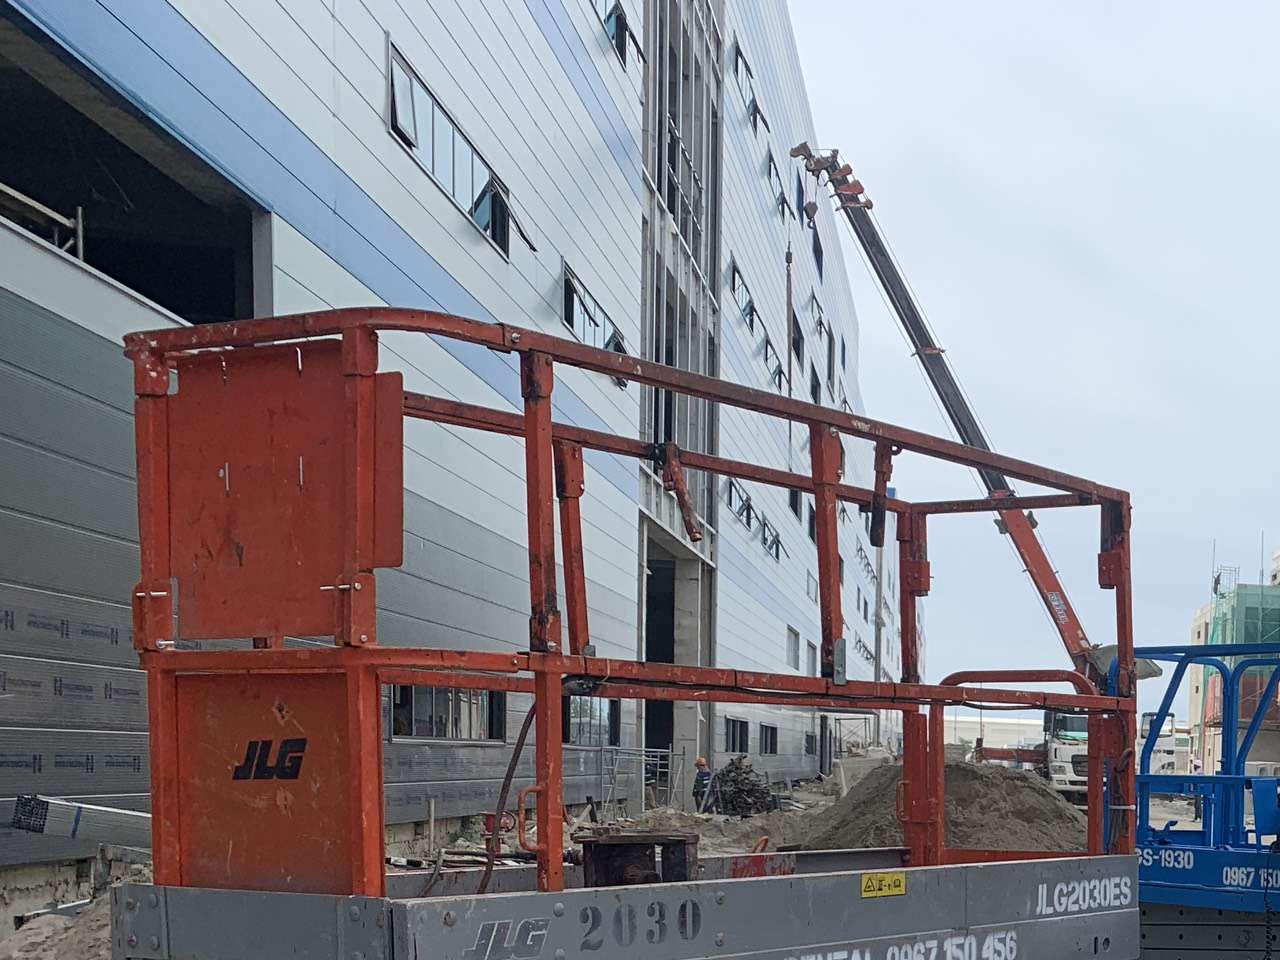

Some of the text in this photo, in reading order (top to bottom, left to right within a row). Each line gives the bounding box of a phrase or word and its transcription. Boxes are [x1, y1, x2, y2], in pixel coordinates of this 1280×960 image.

[232, 738, 307, 780] JLG
[1036, 876, 1132, 915] JLG2030ES
[1223, 866, 1254, 887] 0967
[1259, 869, 1280, 889] 150
[579, 899, 703, 952] 2030
